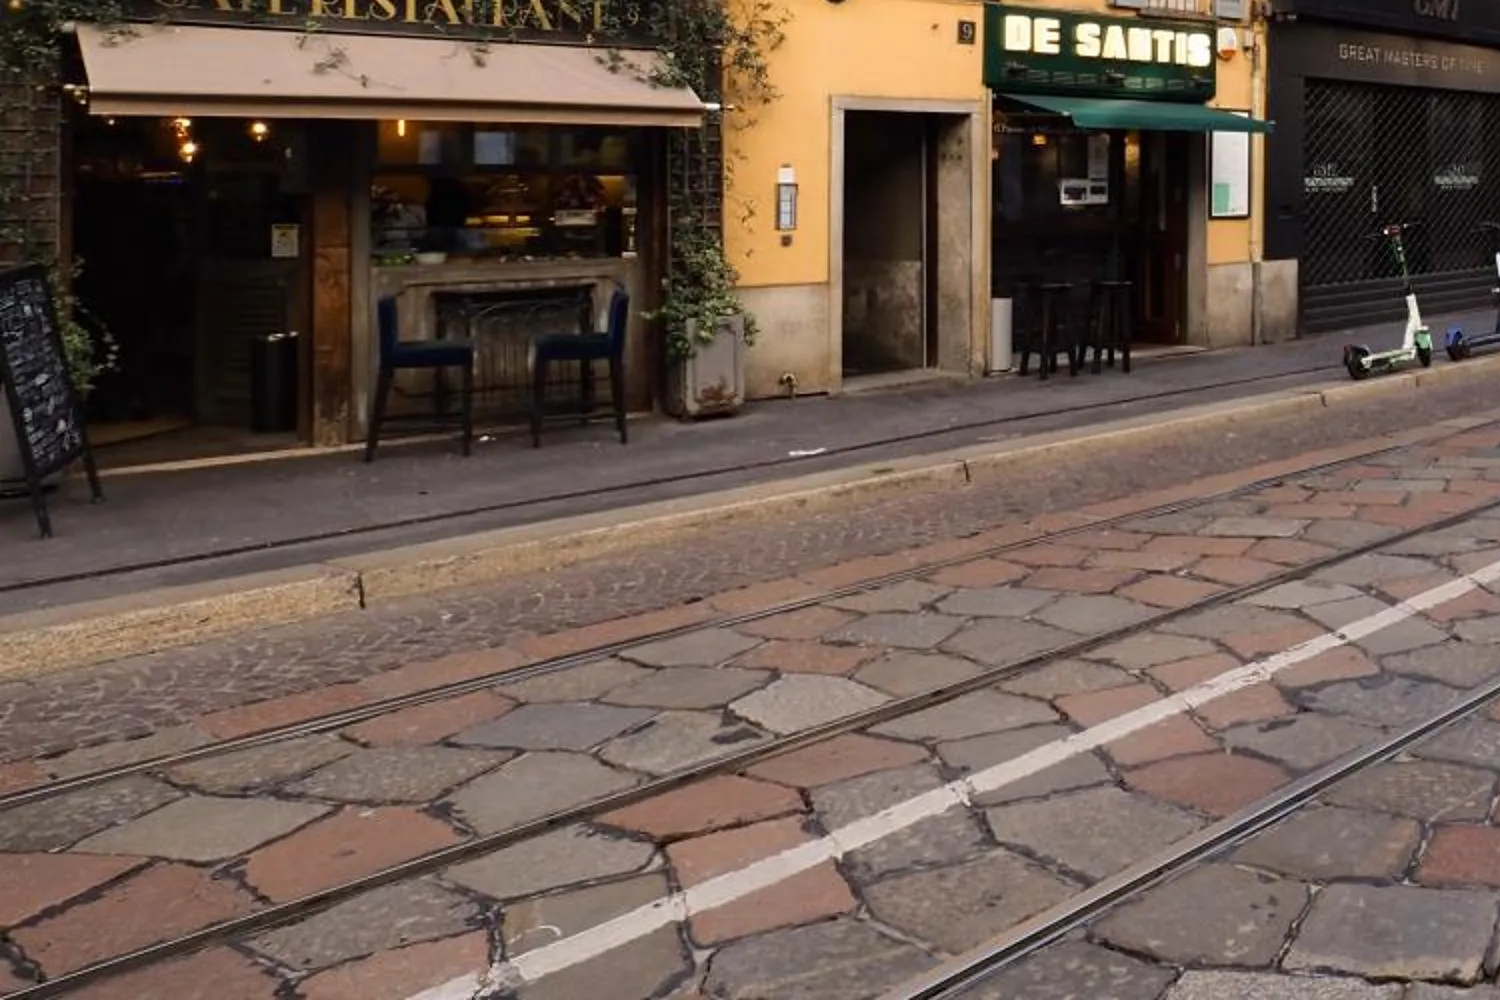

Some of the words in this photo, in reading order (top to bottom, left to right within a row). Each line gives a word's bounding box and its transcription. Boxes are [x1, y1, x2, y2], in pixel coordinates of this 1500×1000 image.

[1003, 14, 1061, 55] DE
[1075, 22, 1212, 67] SANTIS
[1338, 43, 1380, 61] GREAT
[1383, 50, 1438, 70] MASTERS
